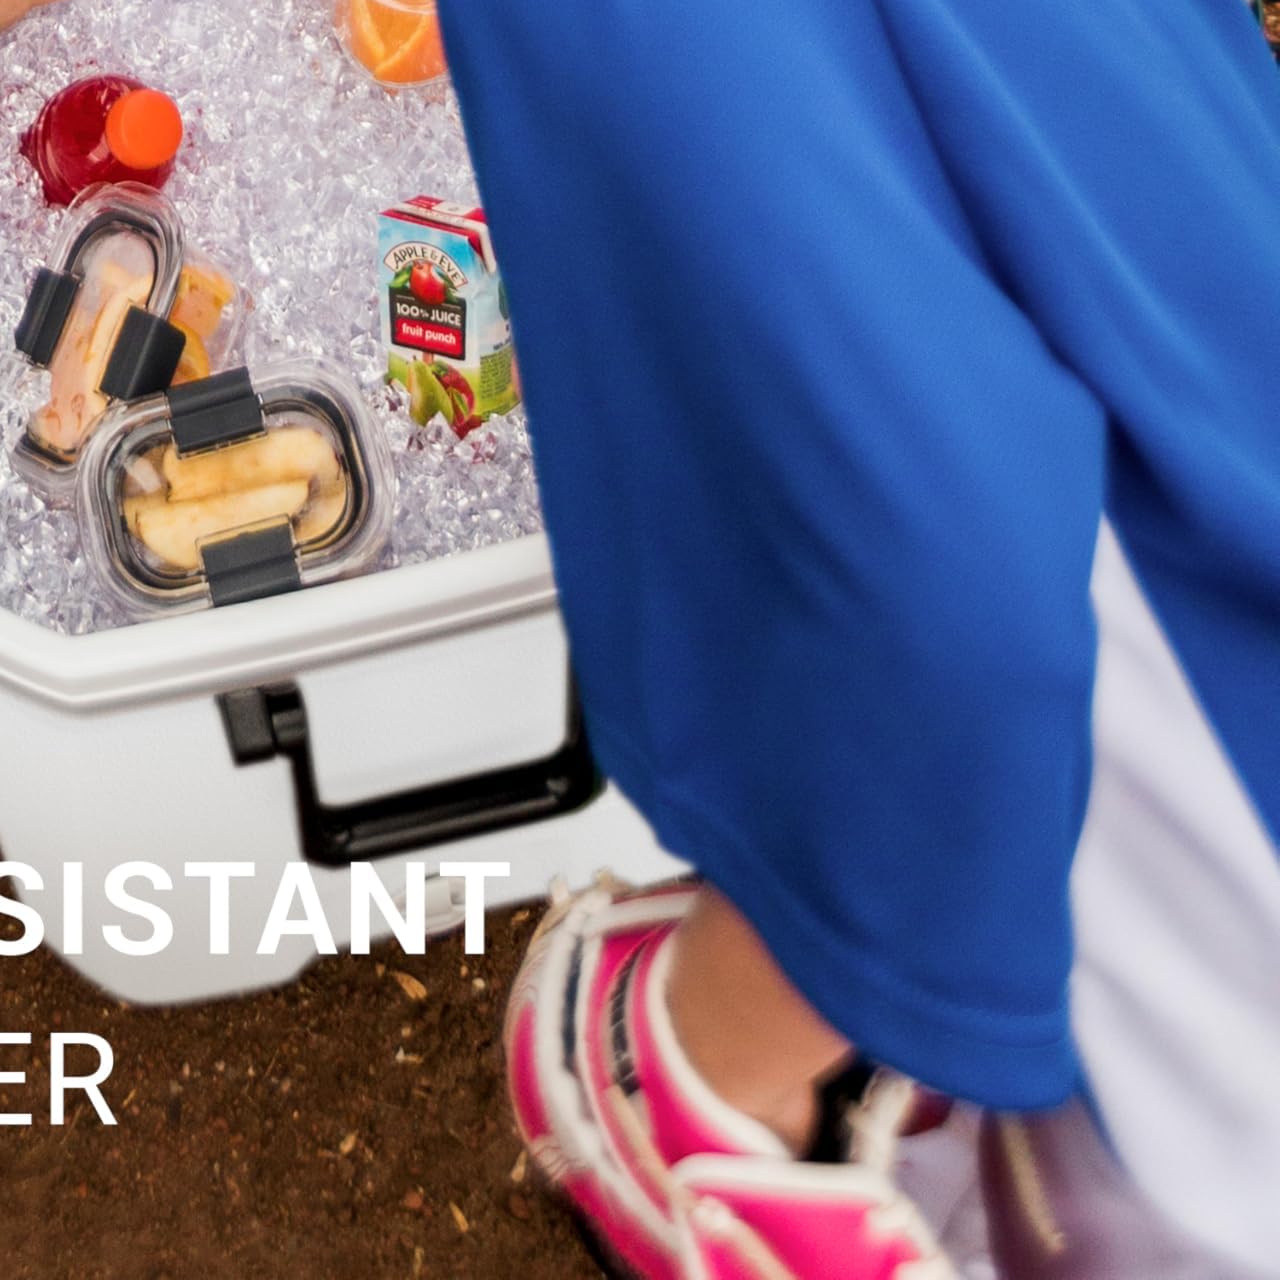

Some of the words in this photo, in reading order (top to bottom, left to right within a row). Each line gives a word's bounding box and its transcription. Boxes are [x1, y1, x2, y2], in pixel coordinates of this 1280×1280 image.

[393, 246, 428, 271] APPLE
[430, 249, 438, 260] &
[439, 255, 460, 281] EVE
[396, 302, 429, 318] 100%
[430, 309, 461, 326] JUICE
[402, 323, 423, 337] fruit
[425, 329, 456, 345] punch
